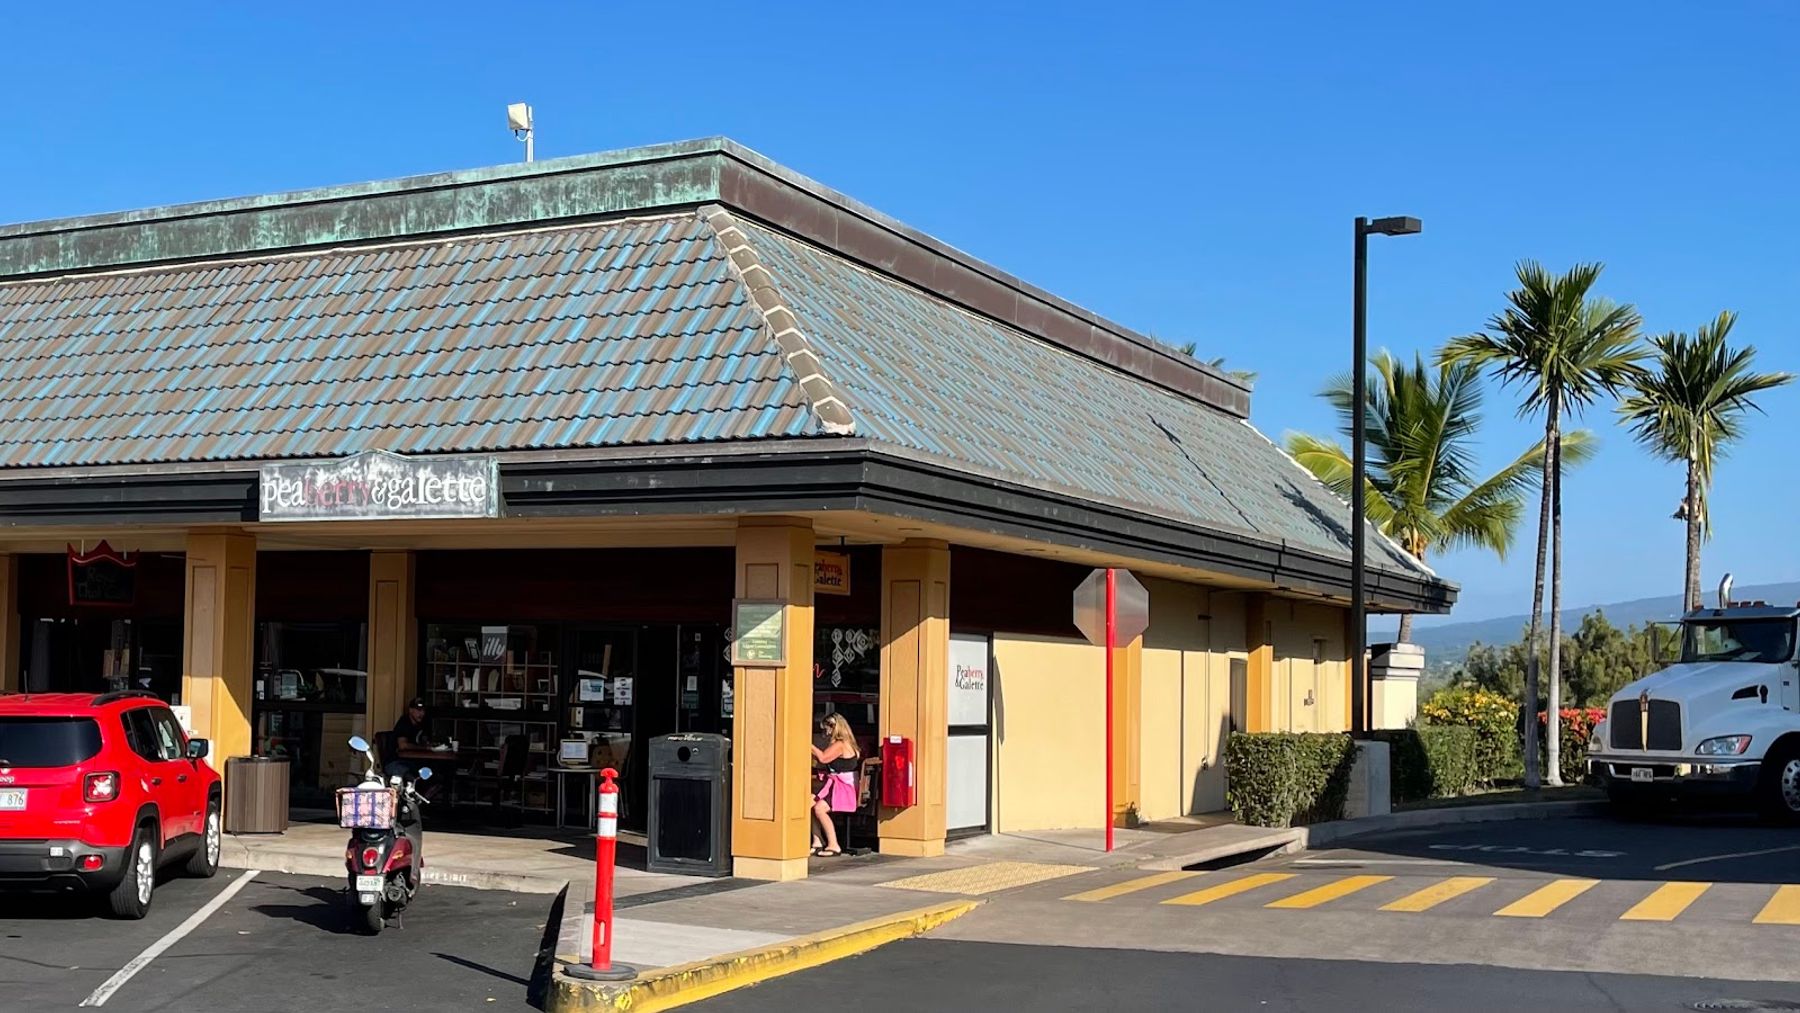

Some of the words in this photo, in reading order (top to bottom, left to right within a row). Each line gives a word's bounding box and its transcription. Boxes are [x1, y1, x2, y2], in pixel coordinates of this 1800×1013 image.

[815, 559, 843, 576] eaberry
[483, 637, 506, 661] illy
[0, 776, 15, 784] eep
[7, 794, 24, 806] 876
